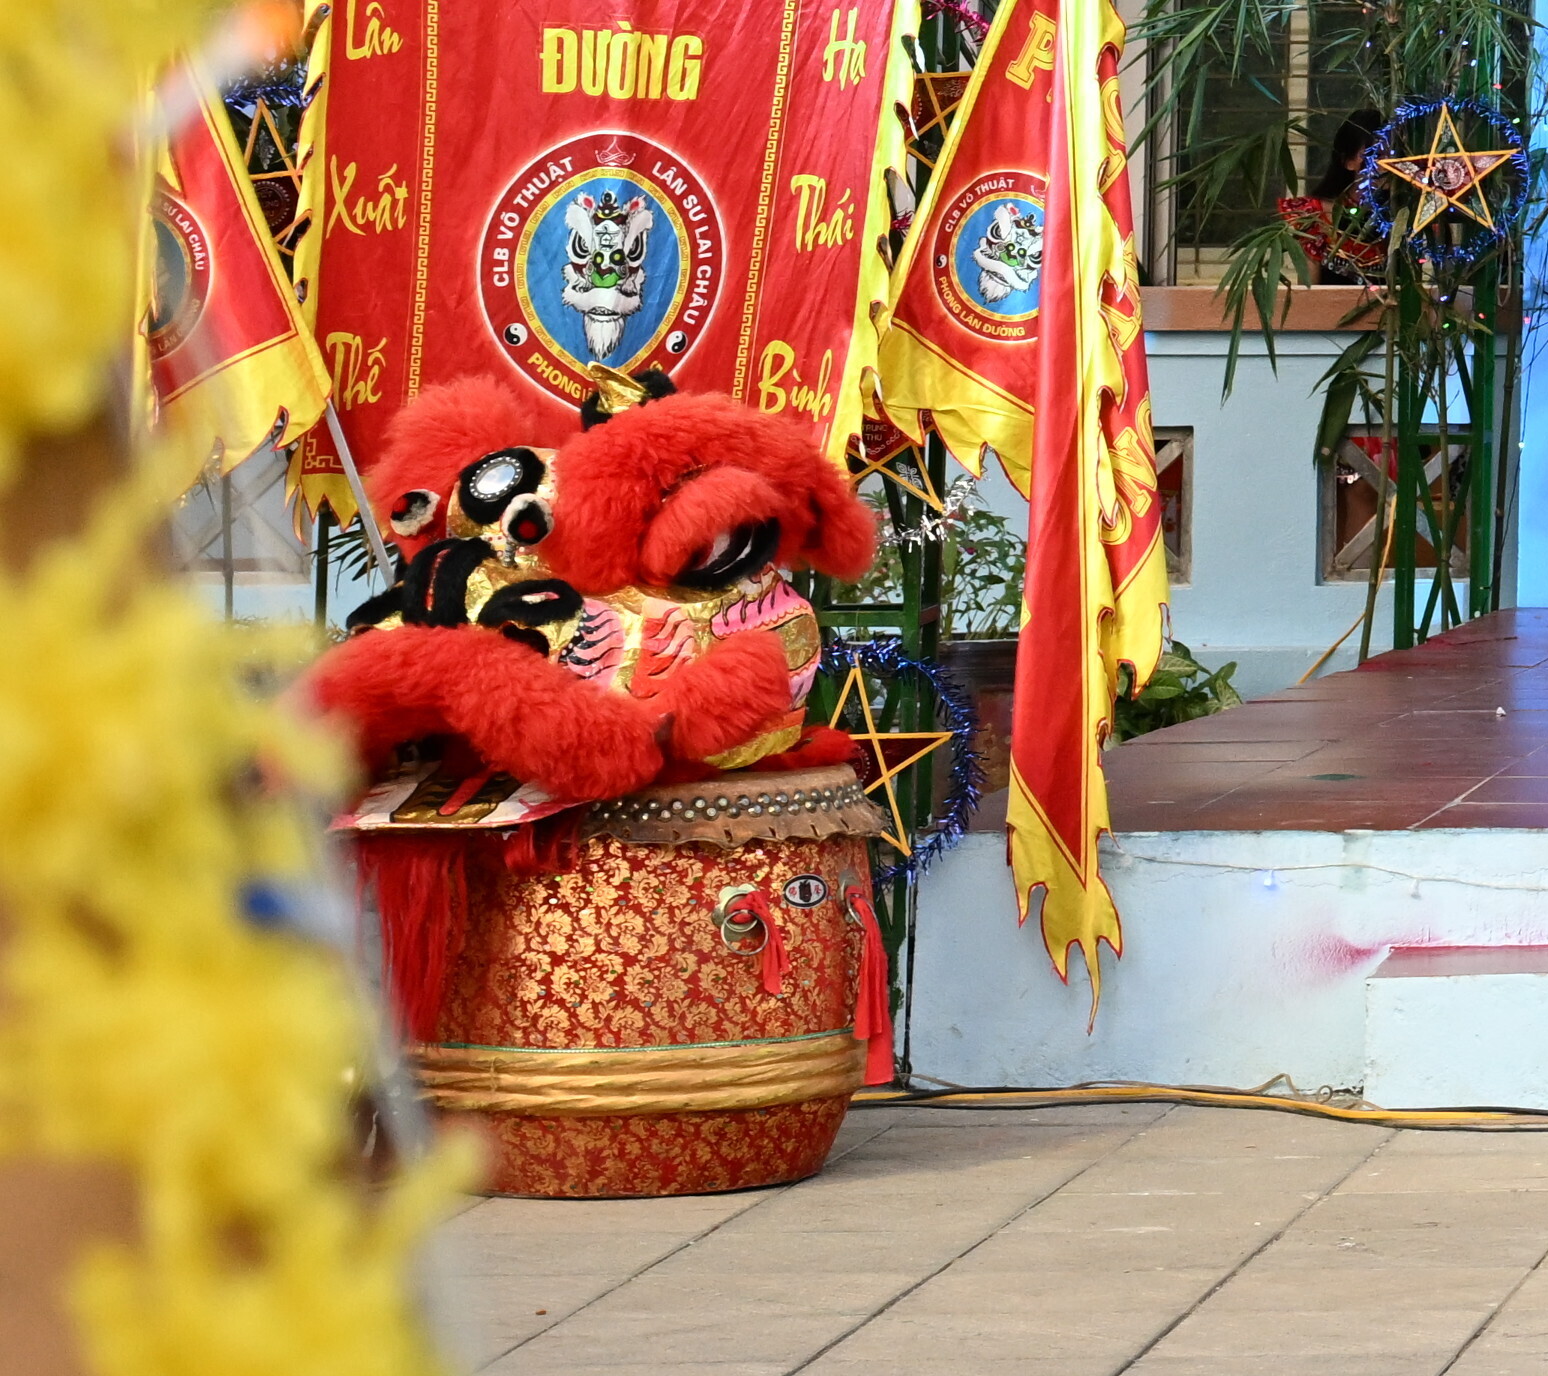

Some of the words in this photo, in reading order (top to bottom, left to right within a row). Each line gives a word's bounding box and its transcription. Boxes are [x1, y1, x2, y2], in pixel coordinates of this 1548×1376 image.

[539, 20, 703, 101] ĐƯỜNG
[822, 6, 866, 94] Hạ
[326, 154, 408, 239] Xuất
[513, 156, 574, 208] THUẬT
[652, 161, 687, 195] LÂN
[945, 209, 961, 233] CLB
[974, 178, 1015, 195] THUẬT
[497, 212, 520, 243] VÕ
[683, 195, 707, 221] SƯ
[790, 173, 854, 253] Thái
[175, 212, 193, 234] LAI
[188, 233, 205, 271] CHÂU
[494, 248, 510, 287] CLB
[695, 225, 712, 259] LAI
[683, 265, 712, 325] CHÂU
[938, 276, 962, 315] PHONG
[959, 310, 983, 330] LÂN
[982, 324, 1026, 337] ĐƯỜNG
[326, 331, 387, 412] Thế
[527, 352, 583, 400] PHONG
[758, 339, 833, 418] Bình
